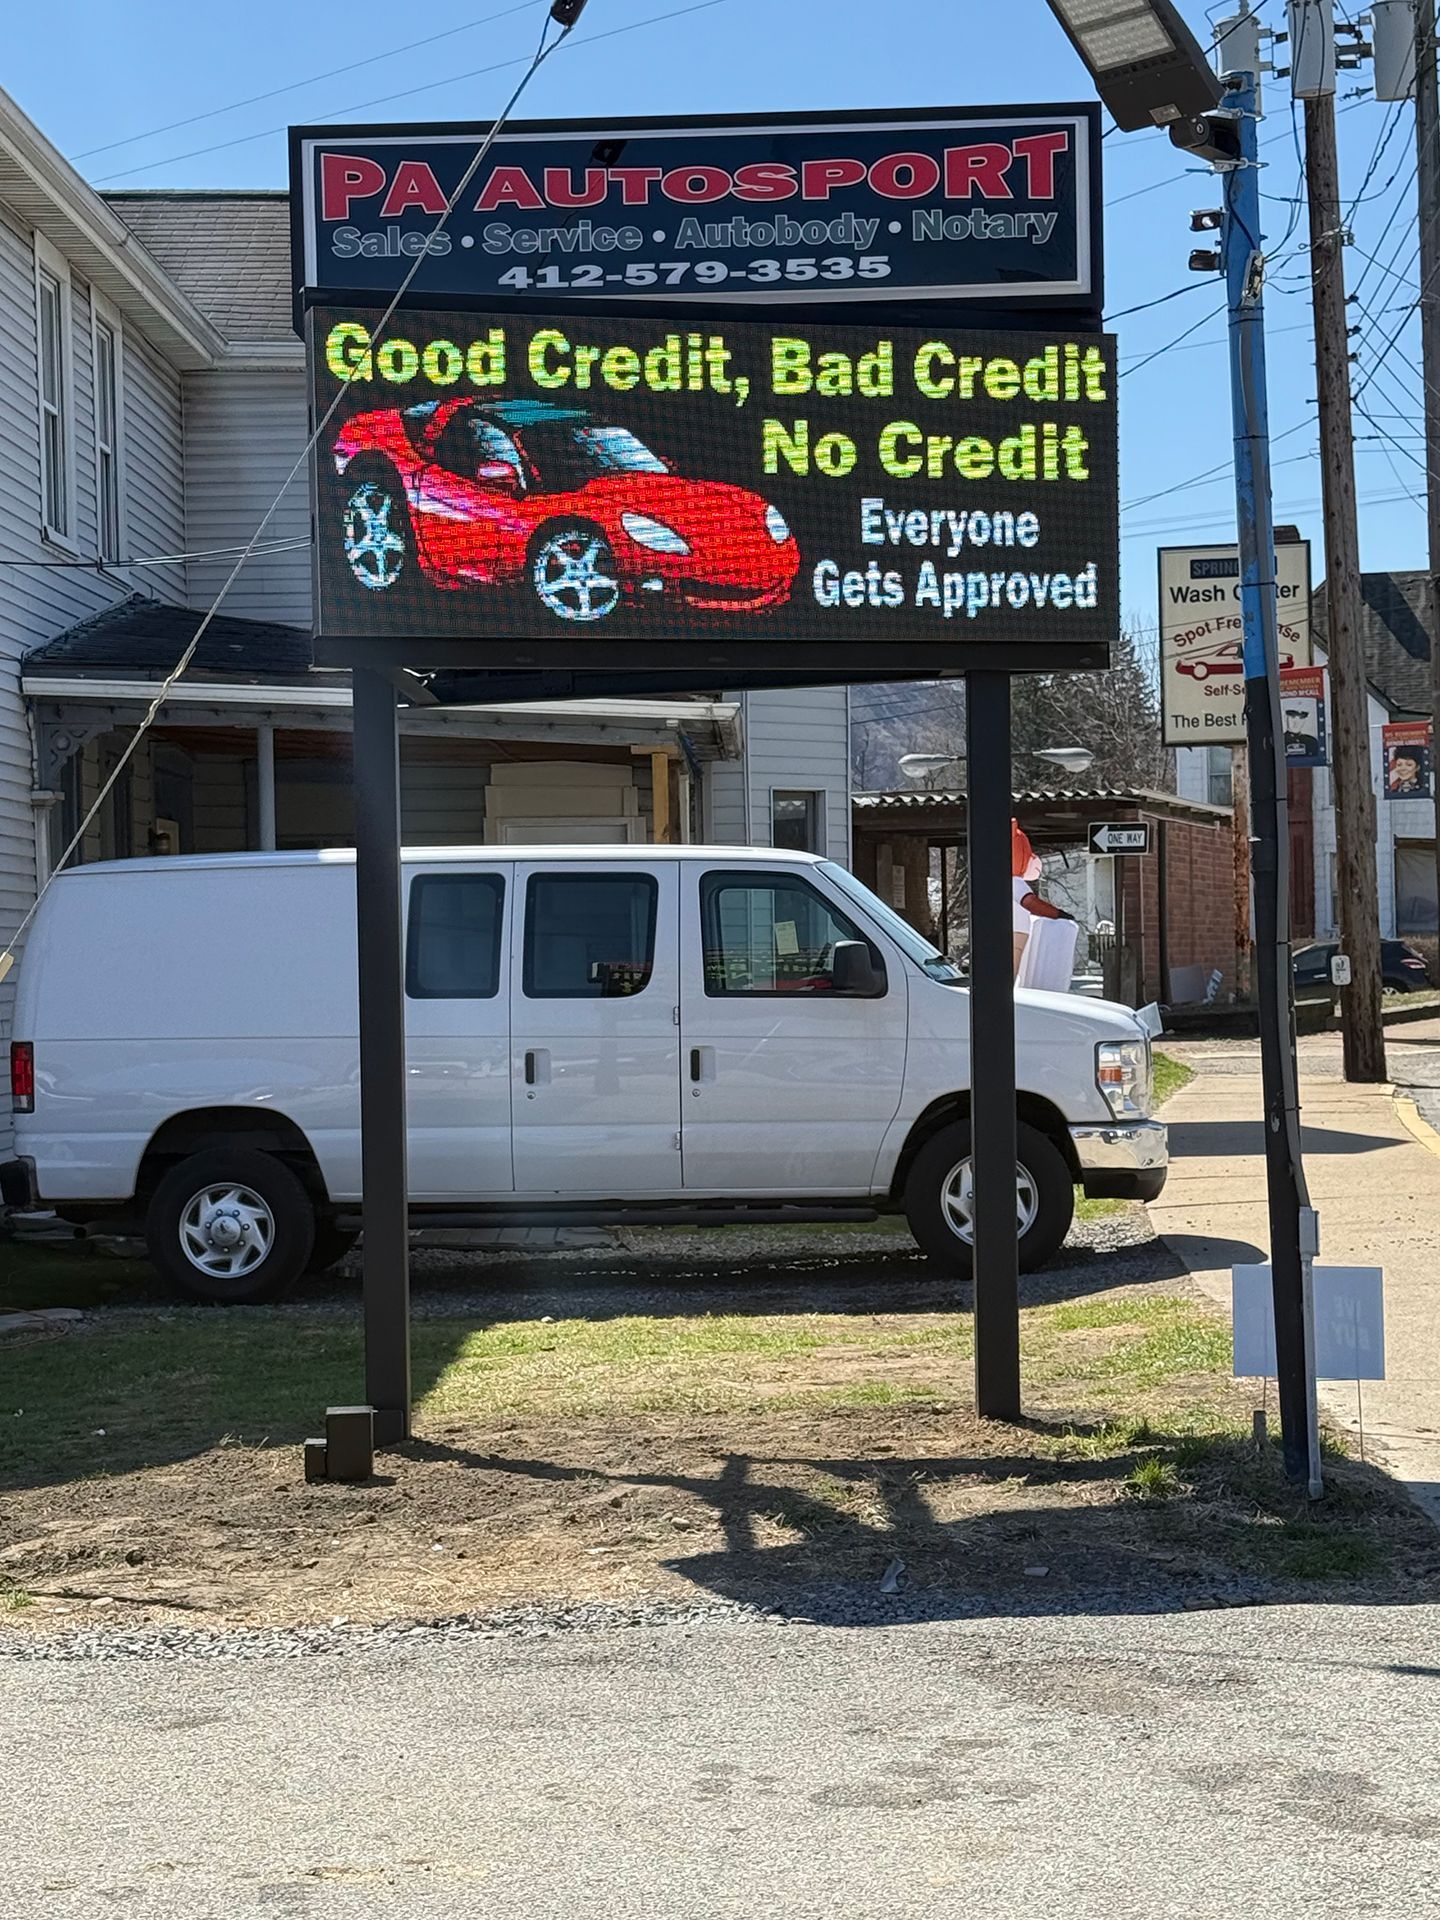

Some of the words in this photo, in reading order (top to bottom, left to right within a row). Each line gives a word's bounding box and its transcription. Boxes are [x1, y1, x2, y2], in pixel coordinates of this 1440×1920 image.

[320, 153, 452, 221] PA
[473, 131, 1068, 212] AUTOSPORT
[331, 225, 452, 258] Sales
[482, 220, 643, 254] Service
[674, 212, 880, 250] Autobody
[912, 208, 1058, 244] Notary
[498, 256, 892, 289] 412-579-3535
[326, 322, 506, 386] Good
[528, 328, 750, 407] Credit,
[771, 337, 894, 398] Bad
[914, 341, 1107, 402] Credit
[761, 418, 858, 477] No
[878, 420, 1090, 481] Credit
[860, 497, 1041, 557] Everyone
[812, 558, 906, 607] Gets
[915, 560, 1099, 618] Approved
[1169, 584, 1226, 604] Wash
[1174, 622, 1213, 647] Spot
[1216, 617, 1242, 631] Fre
[1171, 714, 1200, 728] The
[1204, 713, 1237, 727] Best
[1108, 833, 1124, 844] ONE
[1127, 833, 1143, 844] WAY
